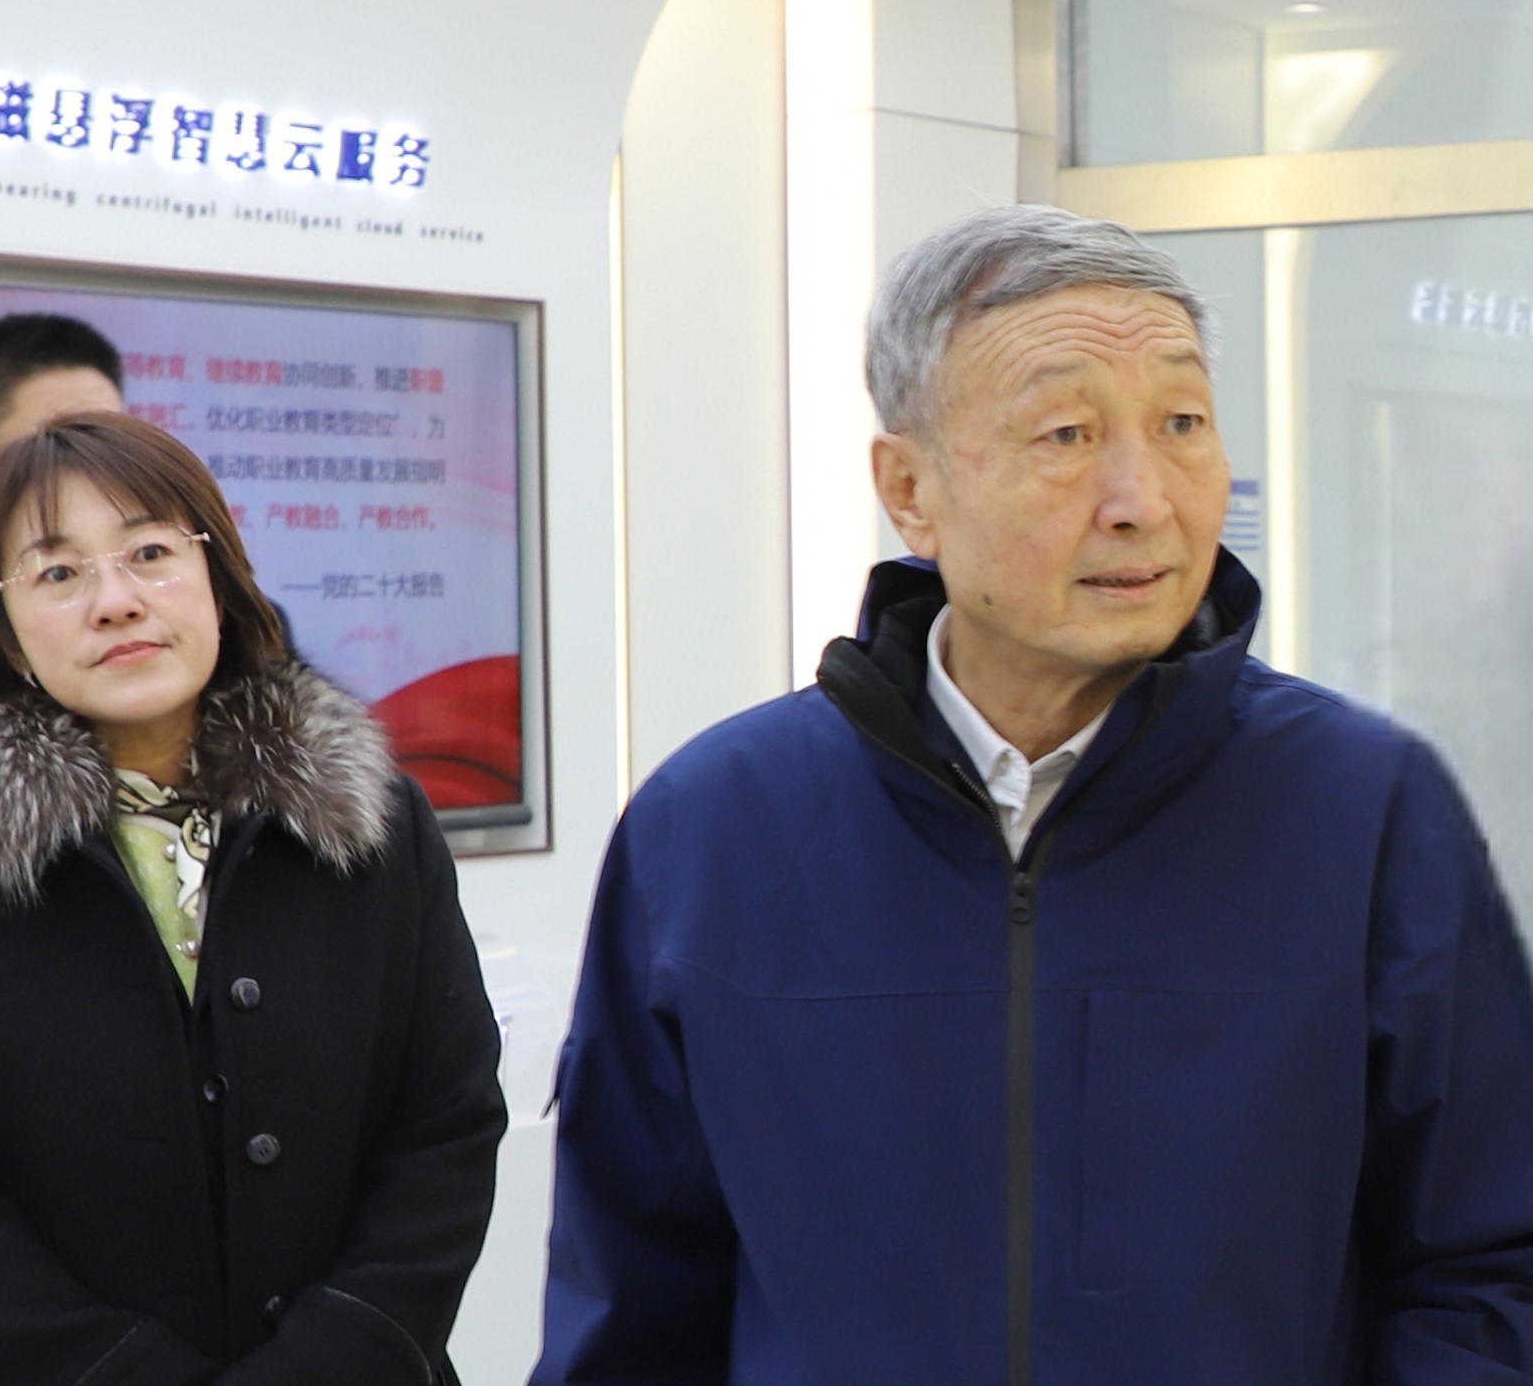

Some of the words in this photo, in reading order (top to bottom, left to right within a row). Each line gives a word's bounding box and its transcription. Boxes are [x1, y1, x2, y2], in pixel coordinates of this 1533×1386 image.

[96, 193, 217, 220] centrifugal
[234, 204, 342, 230] intelligent
[356, 218, 403, 237] cloud
[419, 225, 485, 244] service
